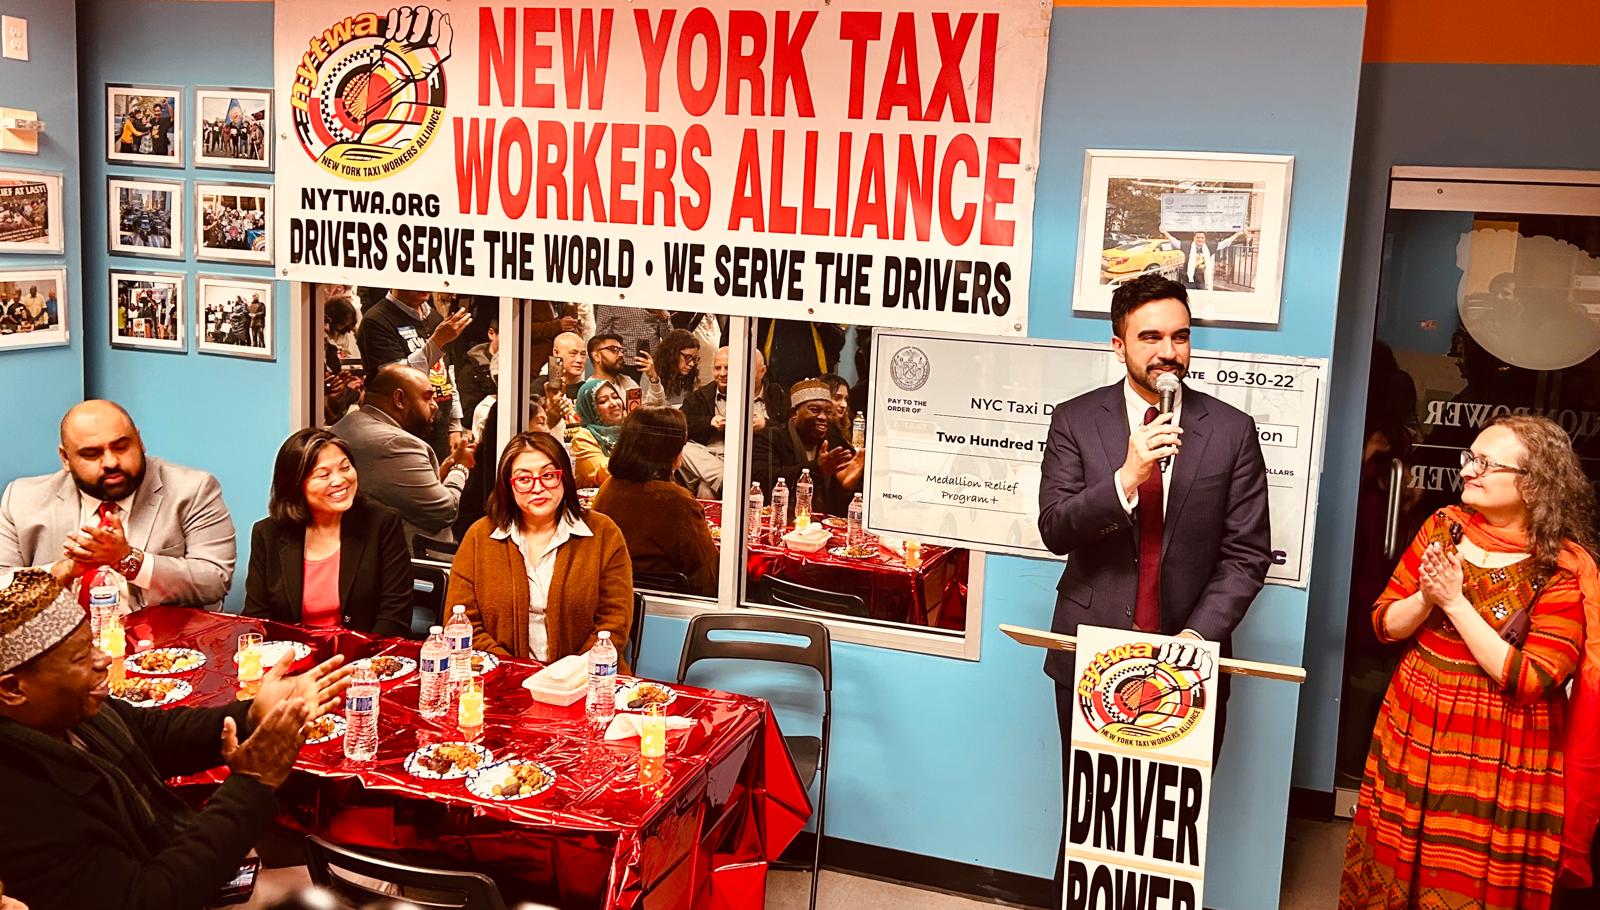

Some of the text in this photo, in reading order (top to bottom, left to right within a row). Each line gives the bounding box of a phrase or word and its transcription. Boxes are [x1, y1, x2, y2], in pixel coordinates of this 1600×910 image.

[290, 12, 378, 112] nytwa
[479, 7, 1000, 123] NEW YORK TAXI
[321, 108, 441, 177] NEW YORK TAXI WORKERS ALLIANCE
[0, 185, 46, 196] IEF AT LAST!
[453, 117, 1021, 246] WORKERS ALLIANCE
[301, 188, 440, 217] NYTWA.ORG
[291, 218, 1011, 316] DRIVERS SERVE THE WORLD WE SERVE THE DRIVERS
[1217, 370, 1294, 388] 09-30-22
[887, 405, 910, 413] ORDER
[971, 398, 1003, 412] NYC
[1007, 401, 1038, 415] Taxi
[936, 431, 965, 444] Two
[970, 434, 1033, 451] Hundred
[926, 475, 1019, 495] Medallion Relief
[1078, 642, 1152, 700] nytwa
[1101, 729, 1116, 741] NEW
[1117, 736, 1133, 746] YORK
[1151, 732, 1181, 746] WORKERS
[1180, 709, 1200, 735] ALLIANCE
[1069, 749, 1203, 867] DRIVER
